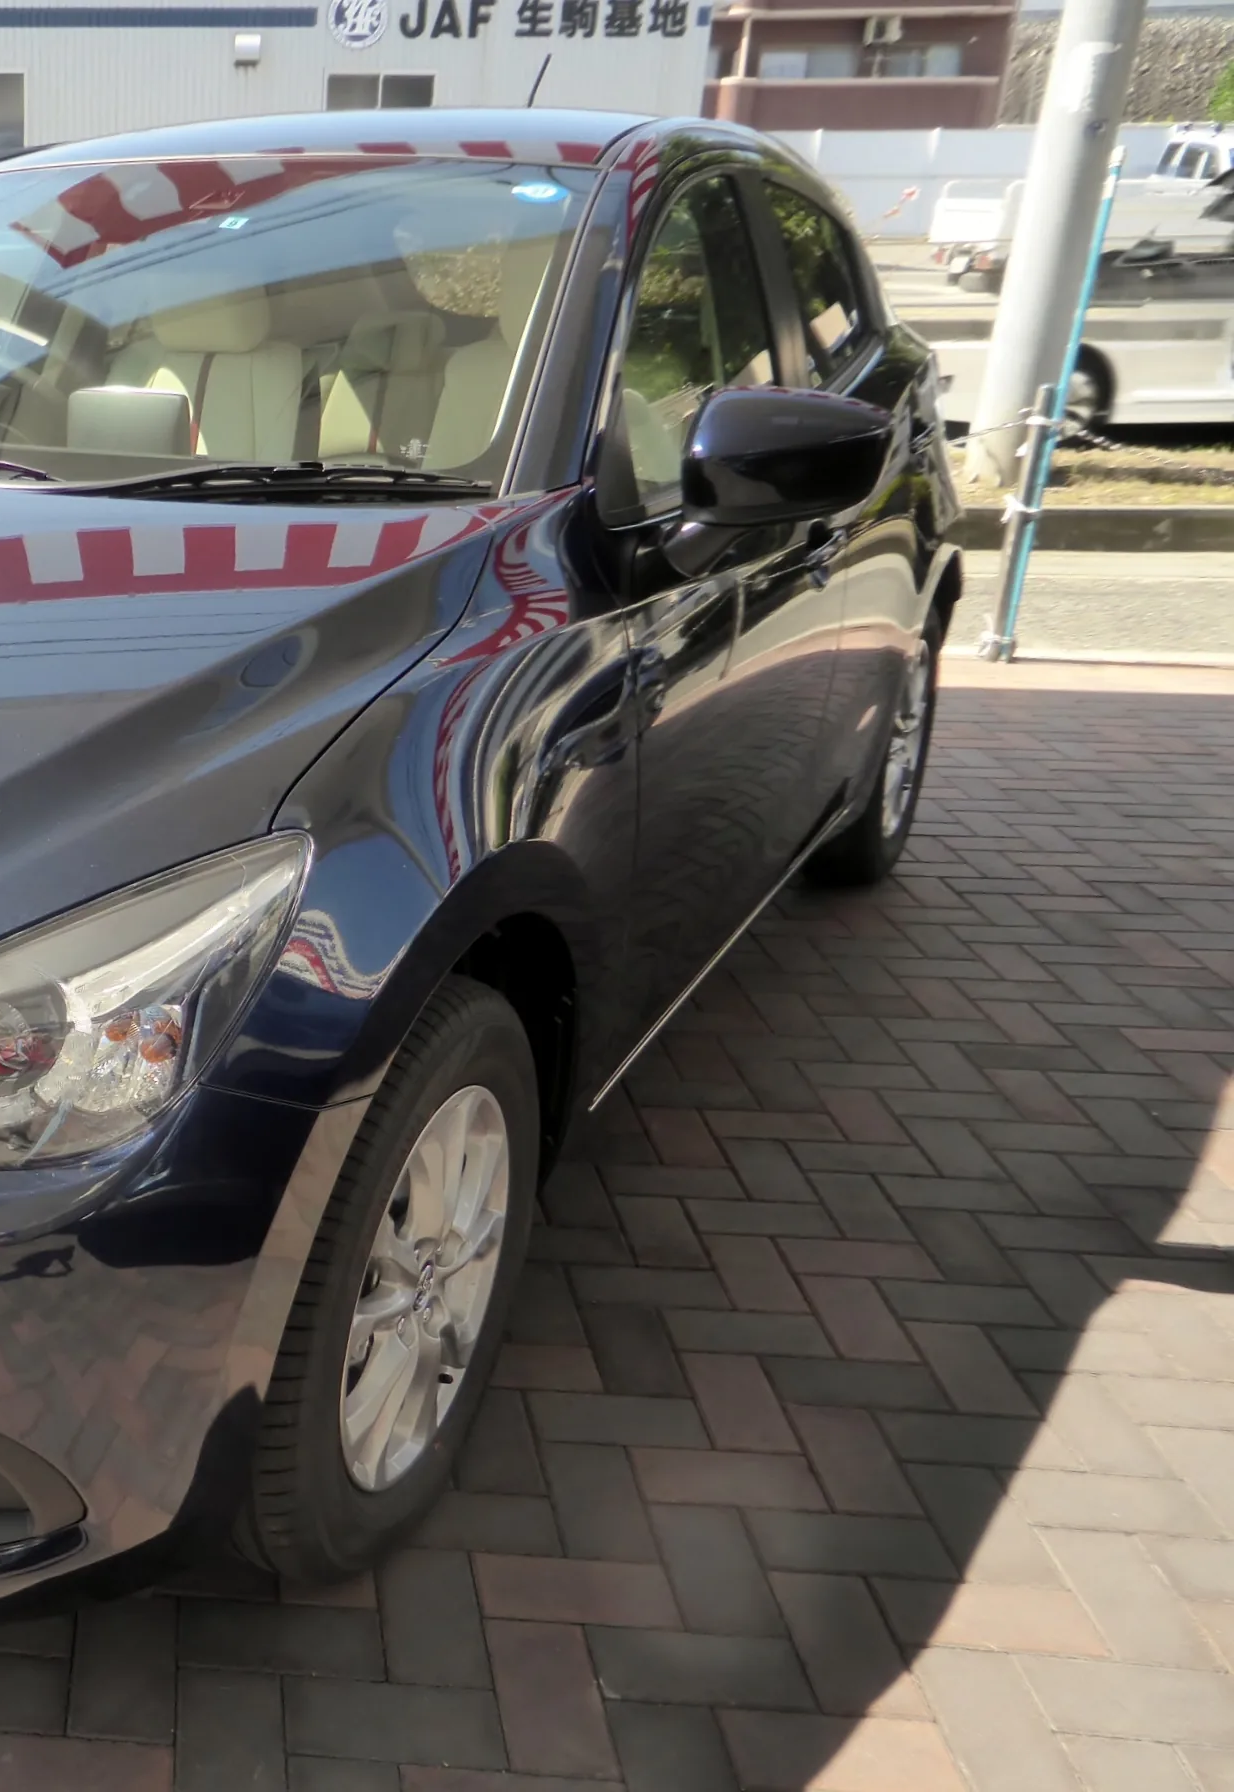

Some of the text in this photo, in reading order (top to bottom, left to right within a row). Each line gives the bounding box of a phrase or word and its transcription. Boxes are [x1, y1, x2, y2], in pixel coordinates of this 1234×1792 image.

[399, 0, 689, 39] JAF 生駒基地
